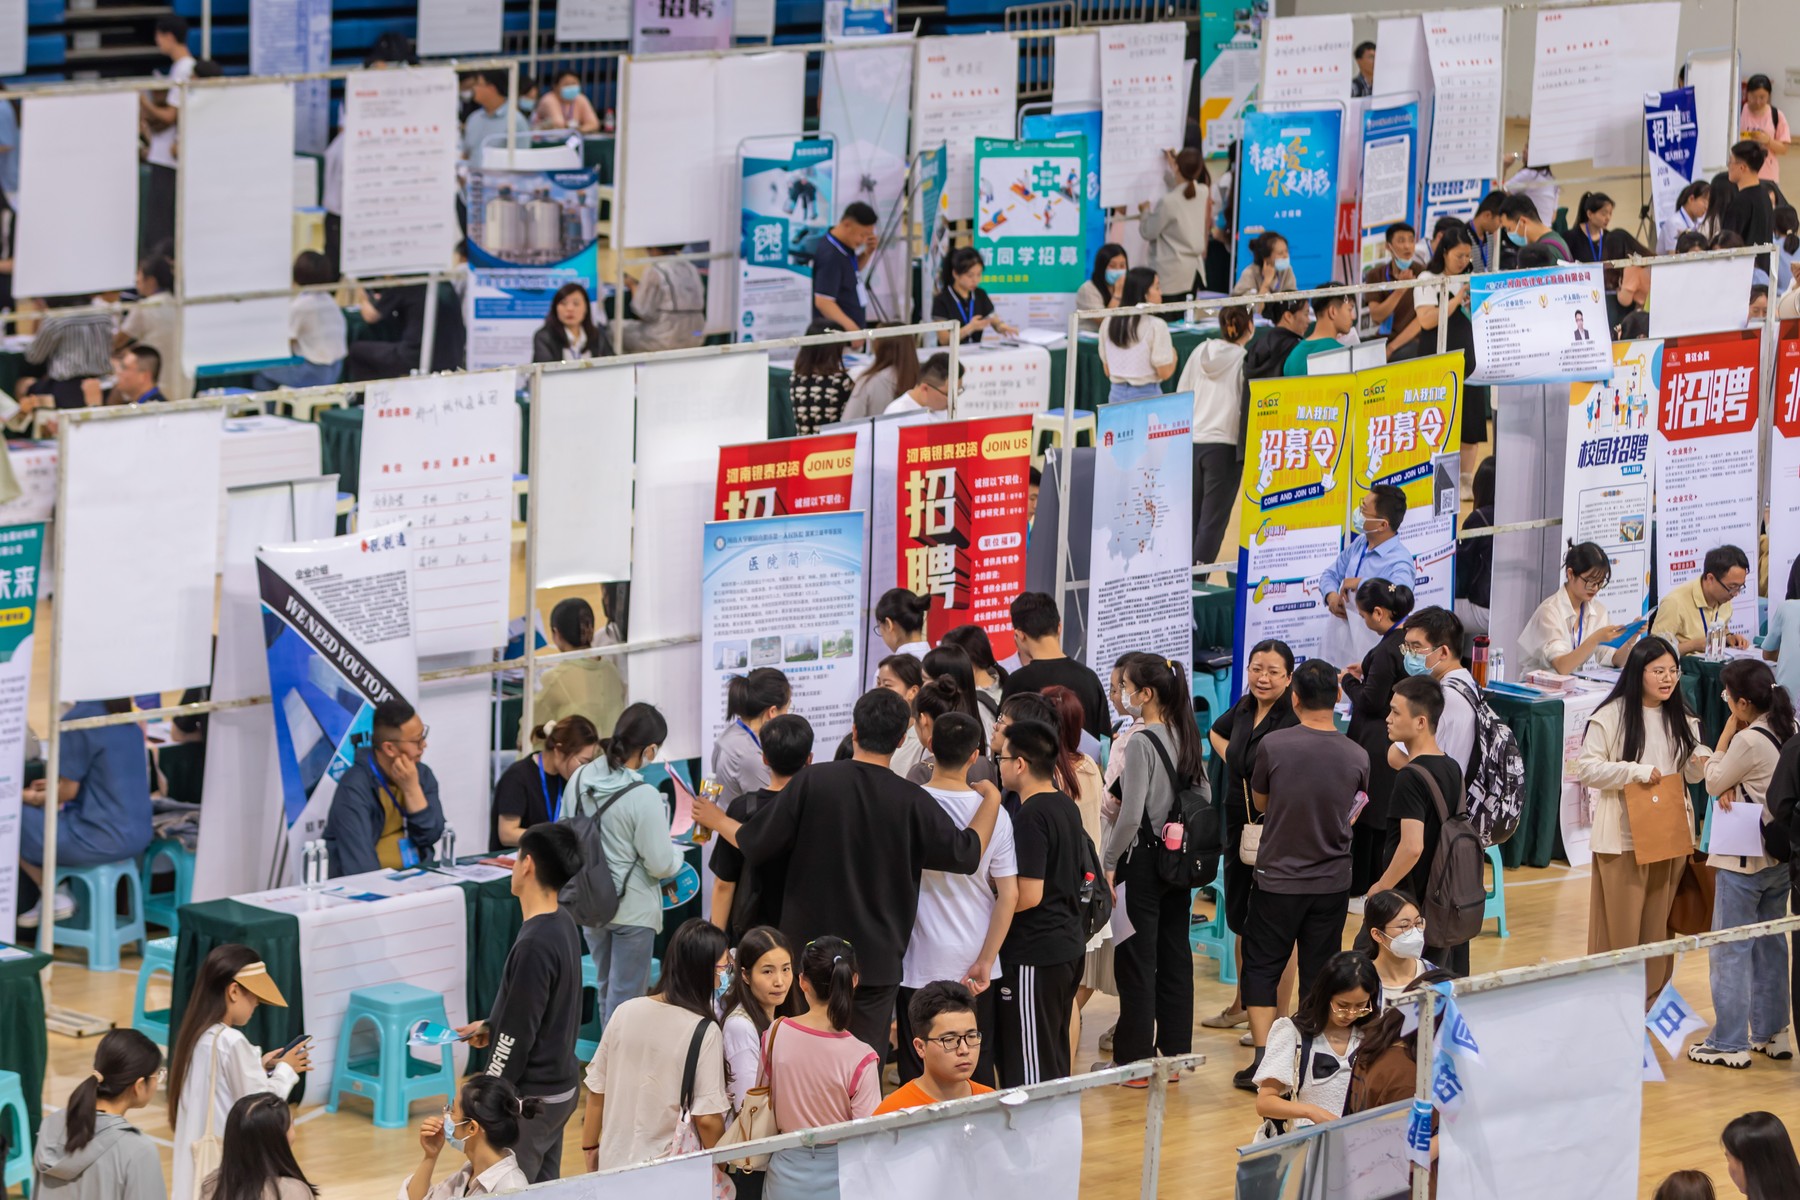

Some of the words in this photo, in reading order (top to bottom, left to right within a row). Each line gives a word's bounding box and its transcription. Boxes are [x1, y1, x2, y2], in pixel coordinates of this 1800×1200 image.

[1653, 104, 1681, 147] 招聘
[979, 246, 1078, 266] 新同学招募
[1664, 366, 1755, 430] 招聘
[1366, 406, 1446, 457] 招募令
[906, 441, 979, 464] 河南银泰投资
[985, 440, 1011, 453] JOIN
[1013, 438, 1028, 449] US
[1258, 427, 1338, 471] 招募令
[1577, 433, 1649, 468] 校园招聘
[726, 460, 800, 485] 河南银泰投资
[807, 459, 834, 472] JOIN
[836, 457, 852, 468] US
[1390, 474, 1402, 485] AND
[1404, 470, 1417, 480] JOIN
[1263, 495, 1279, 506] COME
[1280, 493, 1293, 502] AND
[1294, 488, 1307, 499] JOIN
[904, 466, 959, 610] 招聘
[983, 535, 1017, 548] 职位福利
[295, 565, 329, 580] 企业介绍
[748, 549, 822, 571] 医院简介
[285, 595, 312, 626] WE
[304, 615, 340, 653] NEED
[336, 645, 364, 678] YOU
[361, 671, 381, 695] TO
